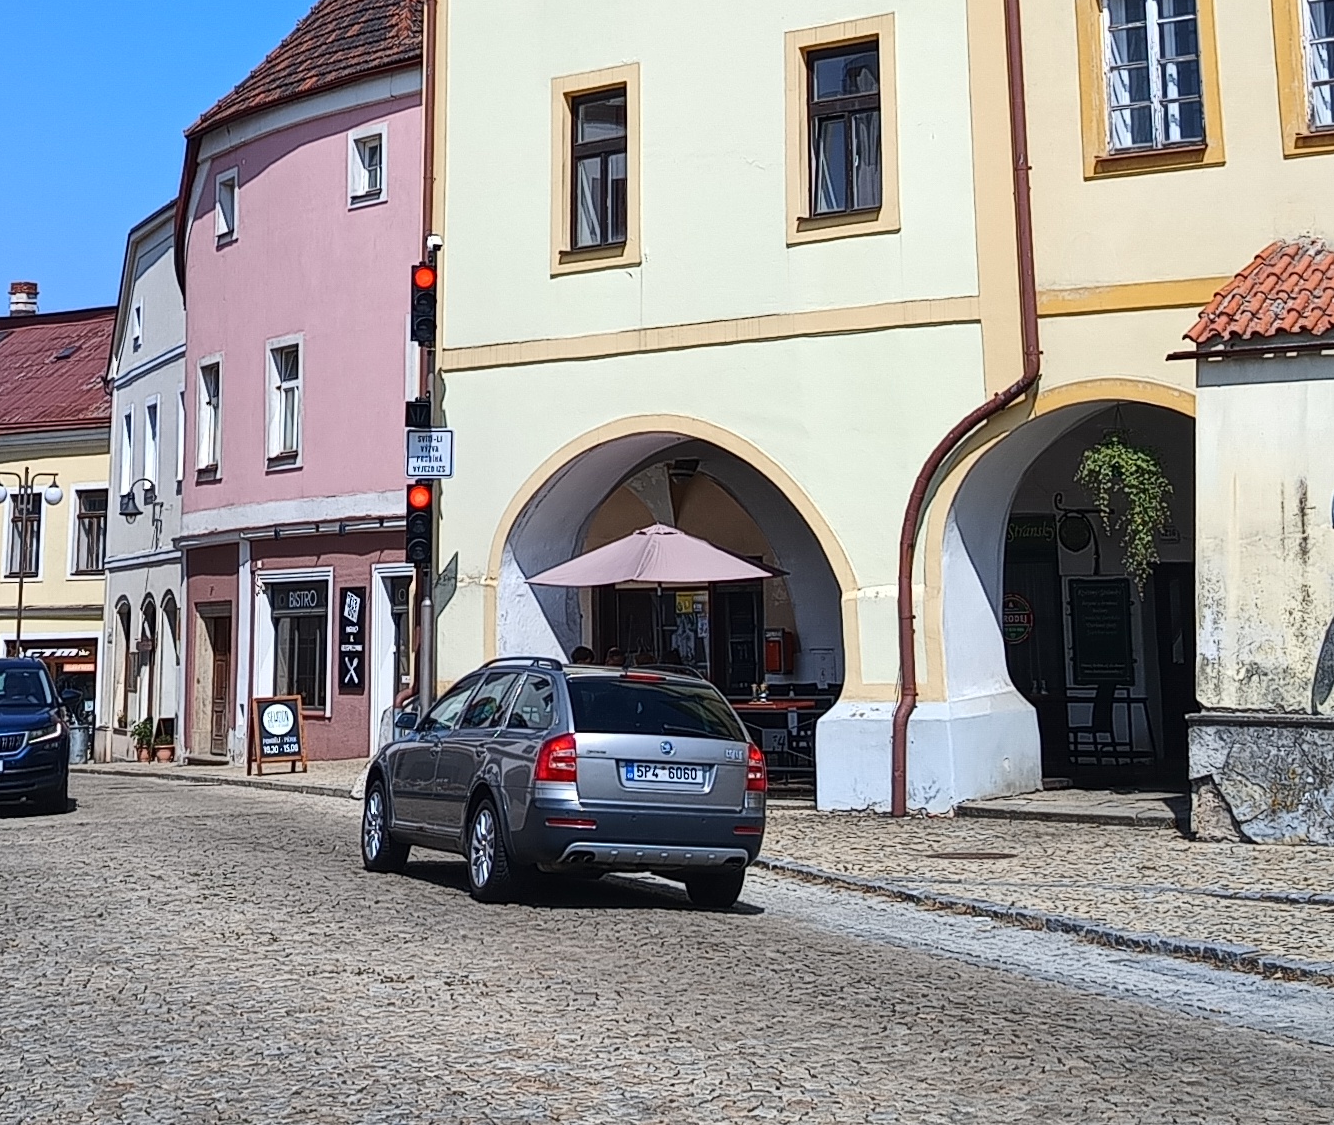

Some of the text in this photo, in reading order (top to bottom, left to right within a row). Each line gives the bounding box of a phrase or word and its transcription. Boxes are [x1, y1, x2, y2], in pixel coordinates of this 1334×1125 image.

[289, 589, 317, 608] BISTRO
[1003, 614, 1028, 624] RODEJ
[636, 764, 698, 780] 5P4 6060
